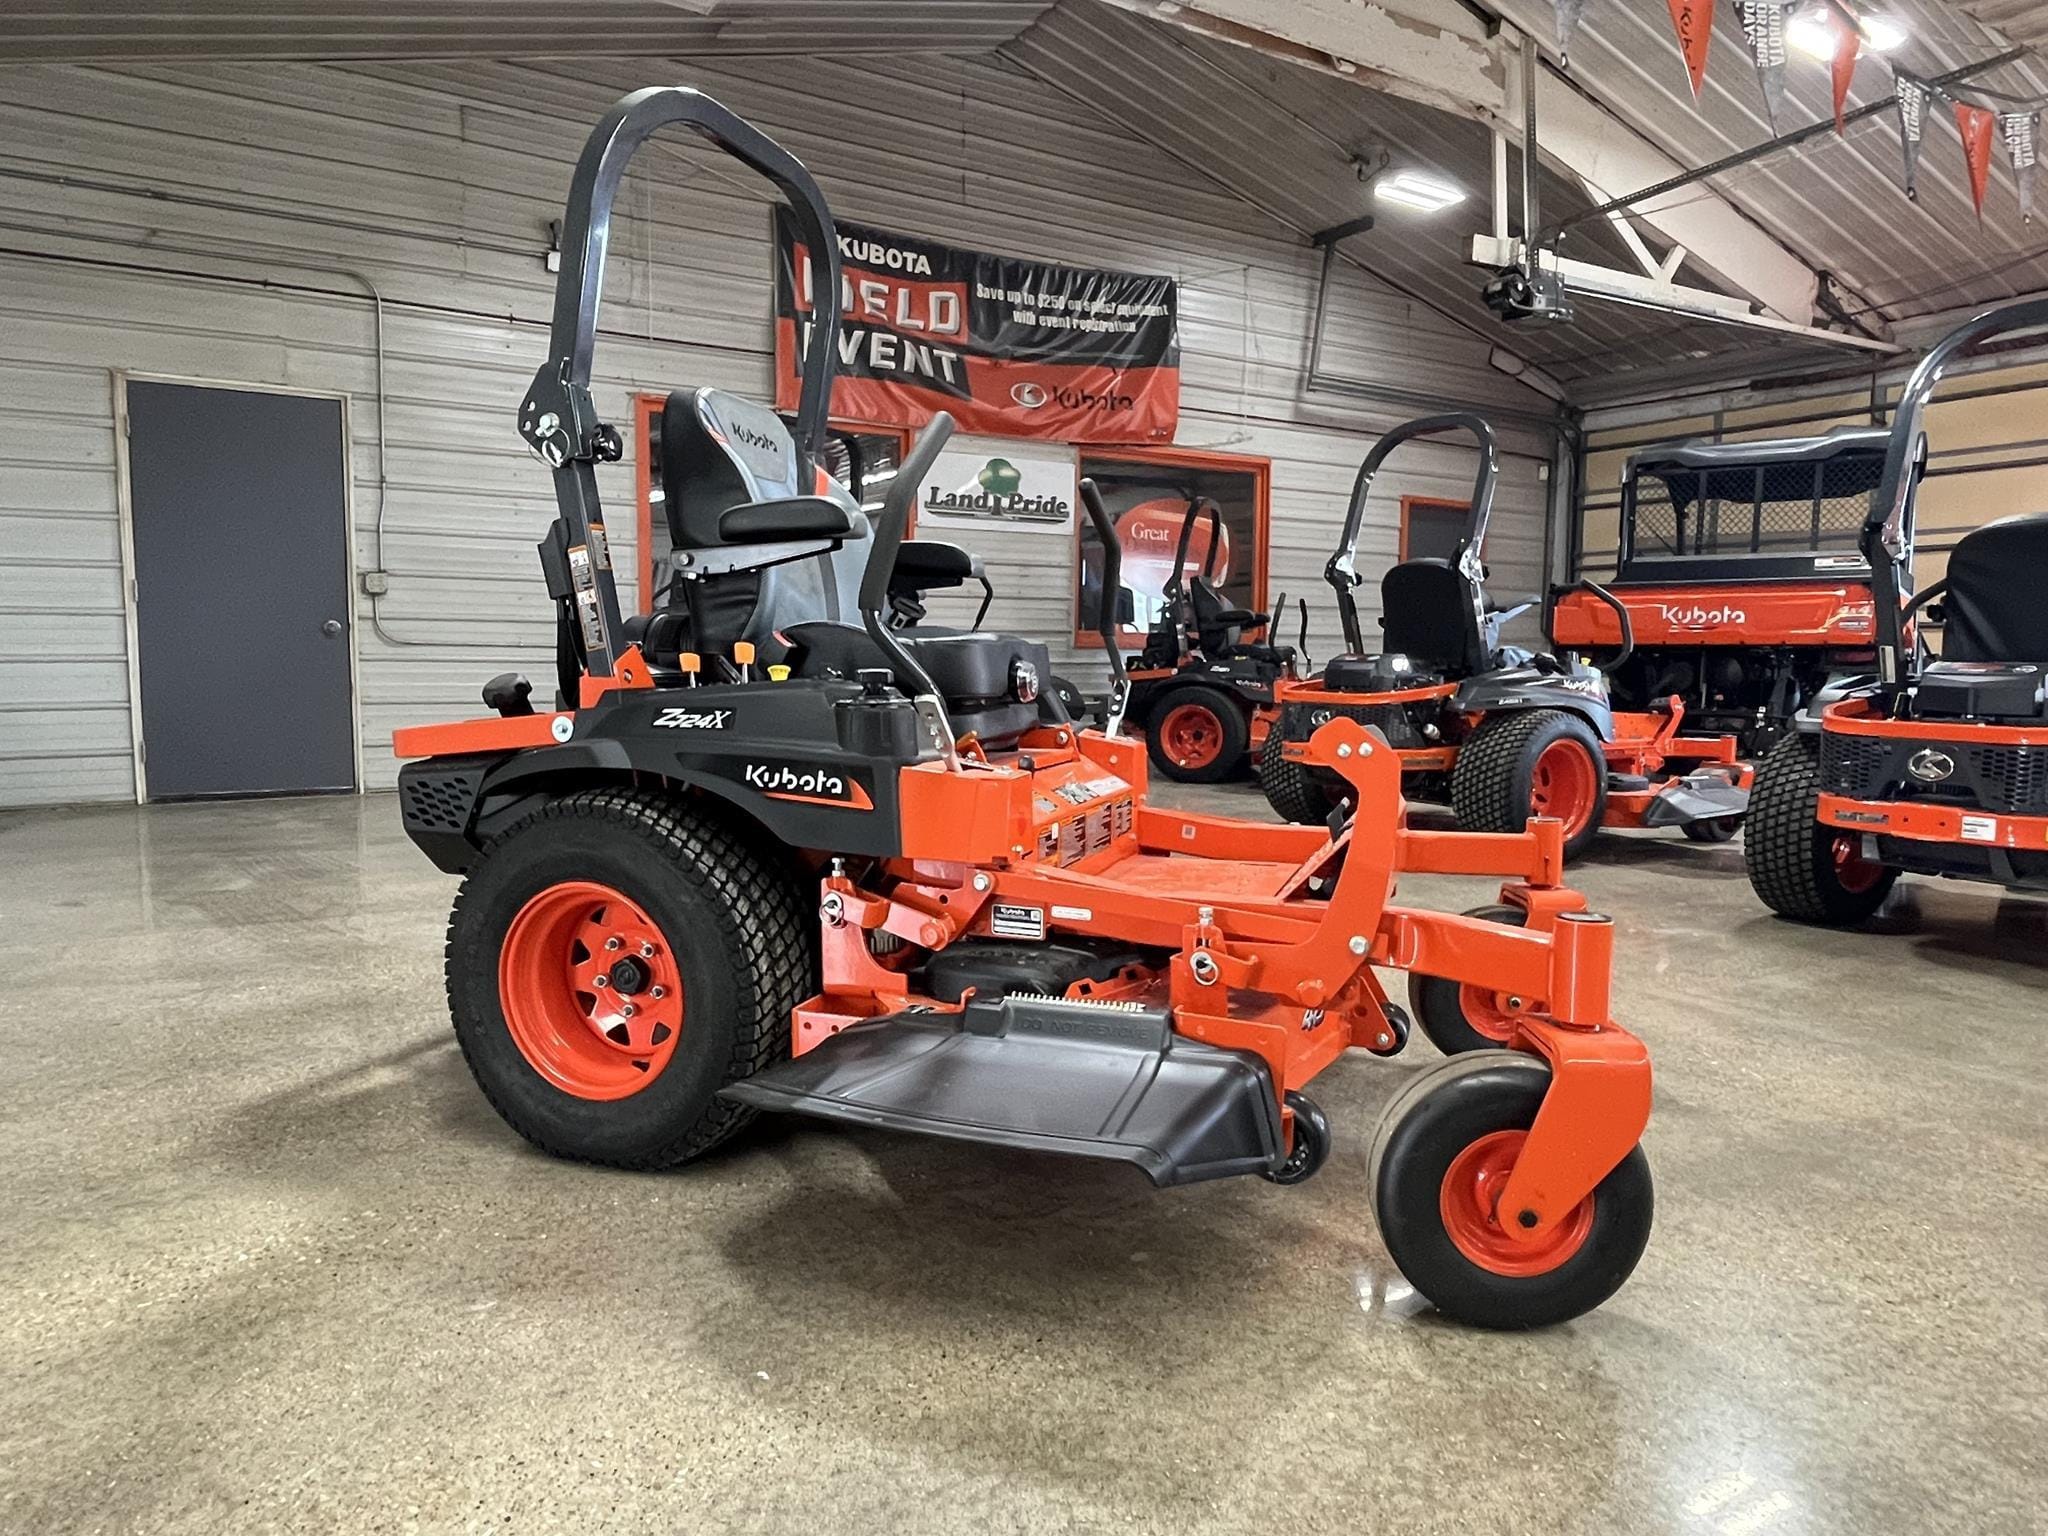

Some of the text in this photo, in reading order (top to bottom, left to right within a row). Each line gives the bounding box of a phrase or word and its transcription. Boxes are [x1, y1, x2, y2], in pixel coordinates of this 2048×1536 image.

[1743, 1, 1755, 45] DAYS
[1756, 3, 1768, 67] ORANGE
[1768, 4, 1785, 66] KUBOTA
[836, 234, 932, 276] KUBOTA
[975, 283, 1004, 301] Save
[1006, 290, 1021, 305] up
[1022, 292, 1036, 307] to
[1037, 293, 1065, 310] $250
[1012, 309, 1136, 334] with event registration
[1052, 385, 1135, 411] Kubota
[731, 422, 778, 453] Kubota
[927, 486, 1069, 516] Land Pride
[1130, 521, 1170, 542] Great
[1662, 605, 1746, 625] Kubota
[652, 707, 733, 729] Z724X
[745, 764, 844, 795] Kubota
[1021, 1017, 1150, 1040] DO NOT REMOVE
